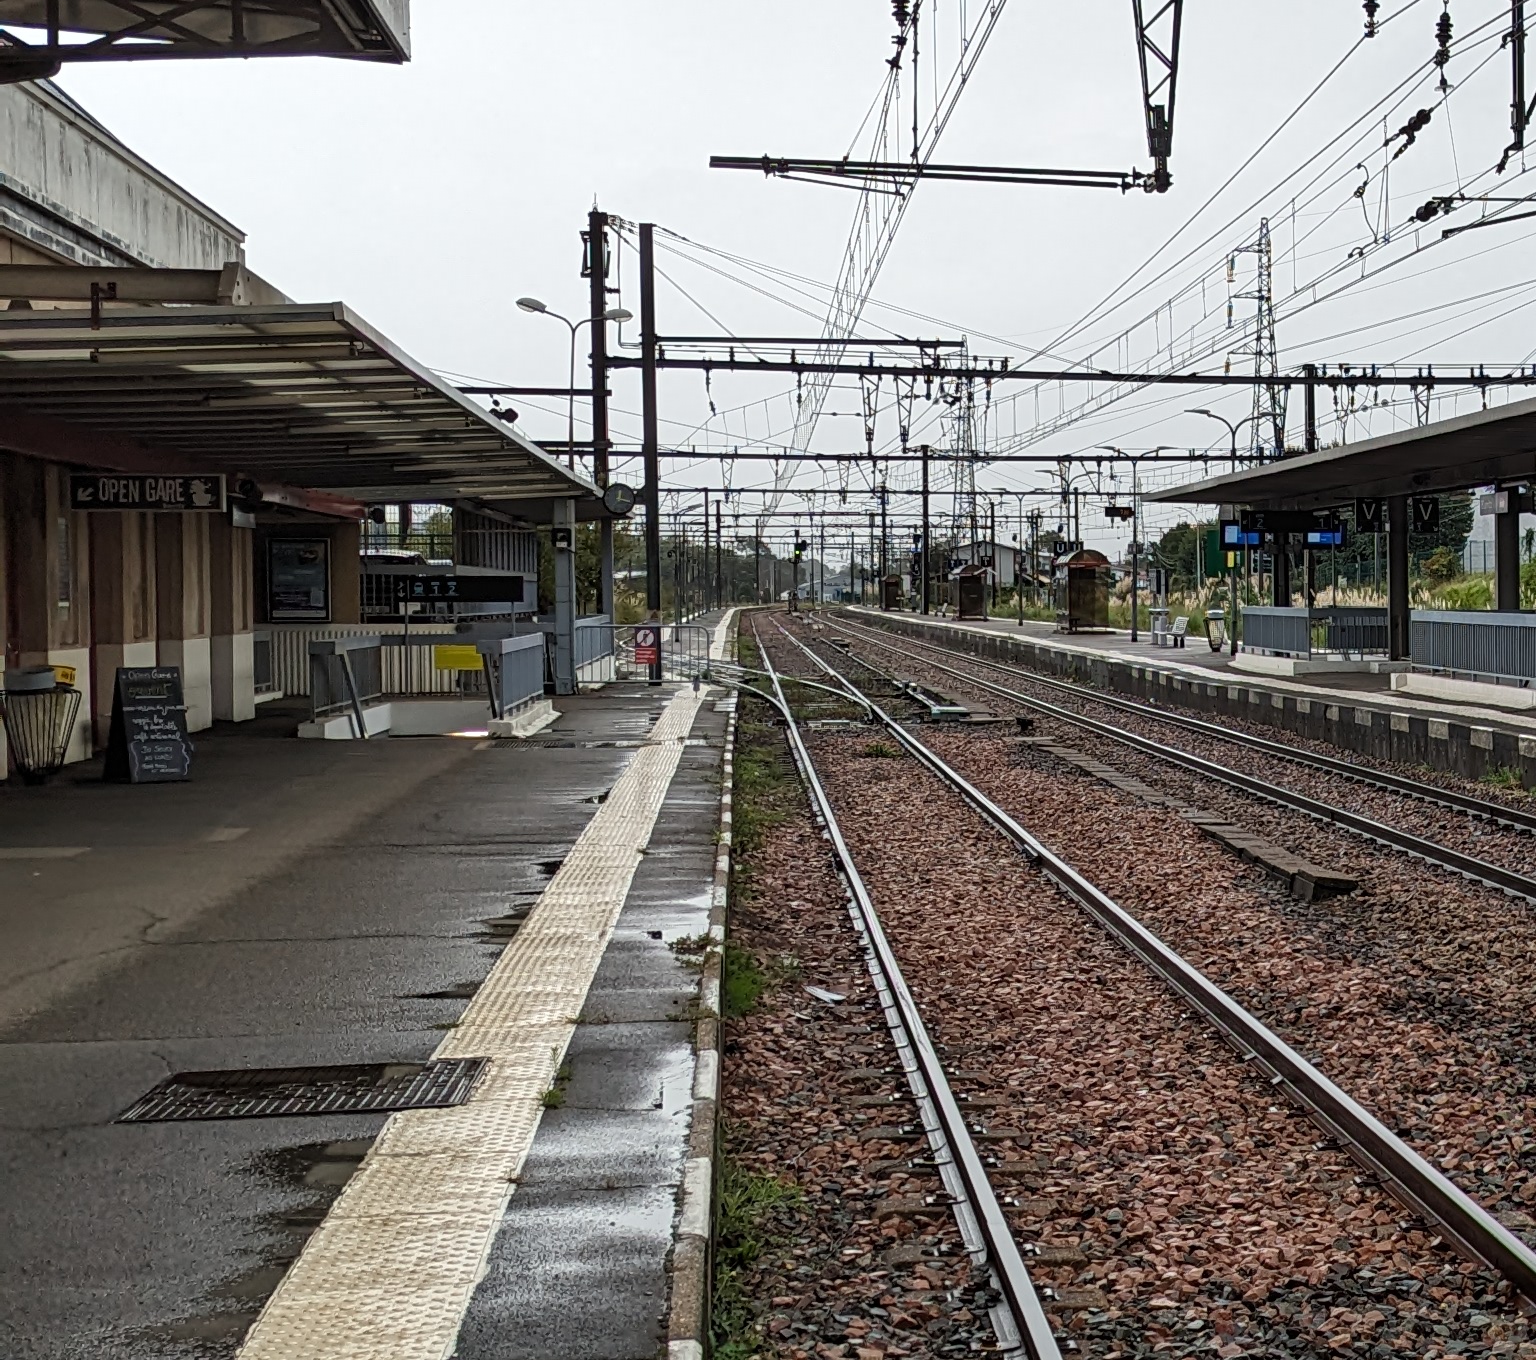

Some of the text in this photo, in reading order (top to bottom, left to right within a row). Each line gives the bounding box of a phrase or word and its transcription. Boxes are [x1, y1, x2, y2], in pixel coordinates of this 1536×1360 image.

[99, 478, 185, 503] OPEN GARE
[1362, 503, 1376, 520] V
[1419, 503, 1433, 521] V
[1256, 519, 1264, 528] 2
[1057, 543, 1065, 553] U
[448, 585, 456, 595] 2
